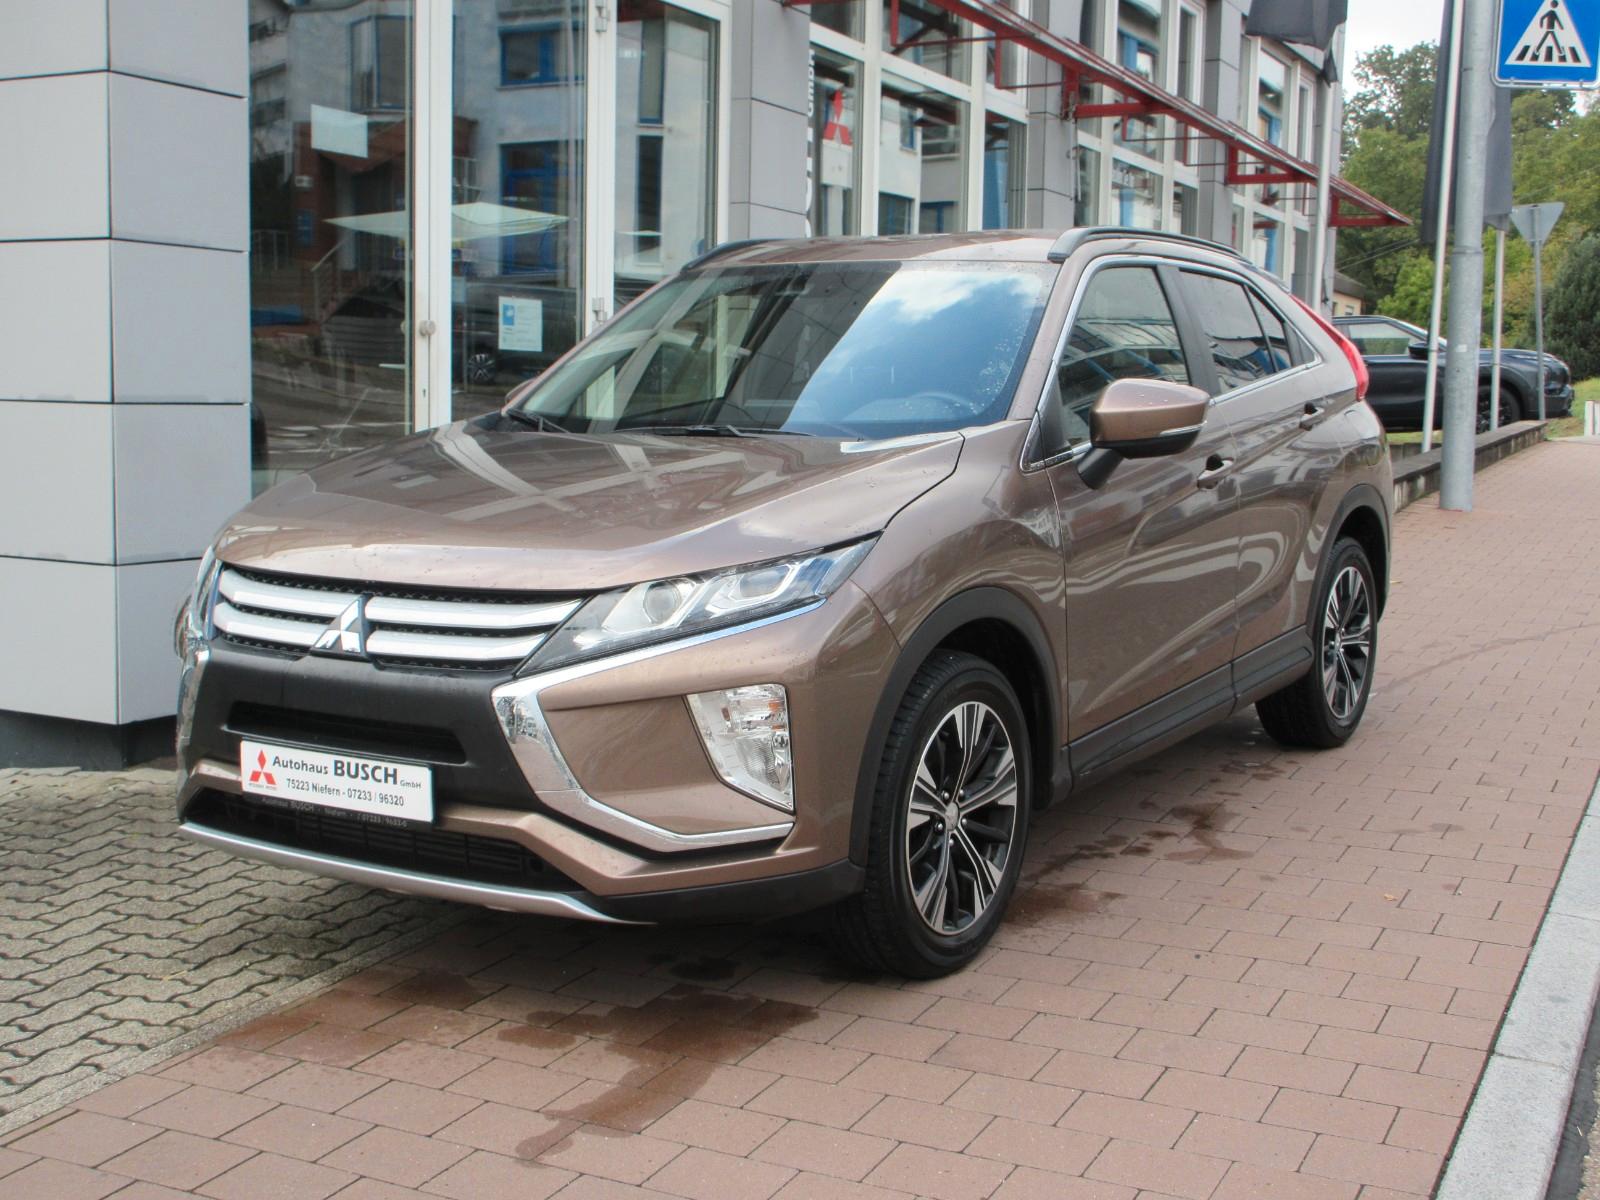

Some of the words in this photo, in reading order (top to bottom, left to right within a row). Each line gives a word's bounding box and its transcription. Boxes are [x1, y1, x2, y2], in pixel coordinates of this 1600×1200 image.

[272, 755, 328, 775] Autohaus
[333, 759, 398, 785] BUSCH
[400, 780, 422, 789] GmbH
[286, 778, 310, 792] 75223
[311, 782, 340, 796] Niefern
[347, 787, 372, 801] 07233
[379, 792, 405, 807] 96320
